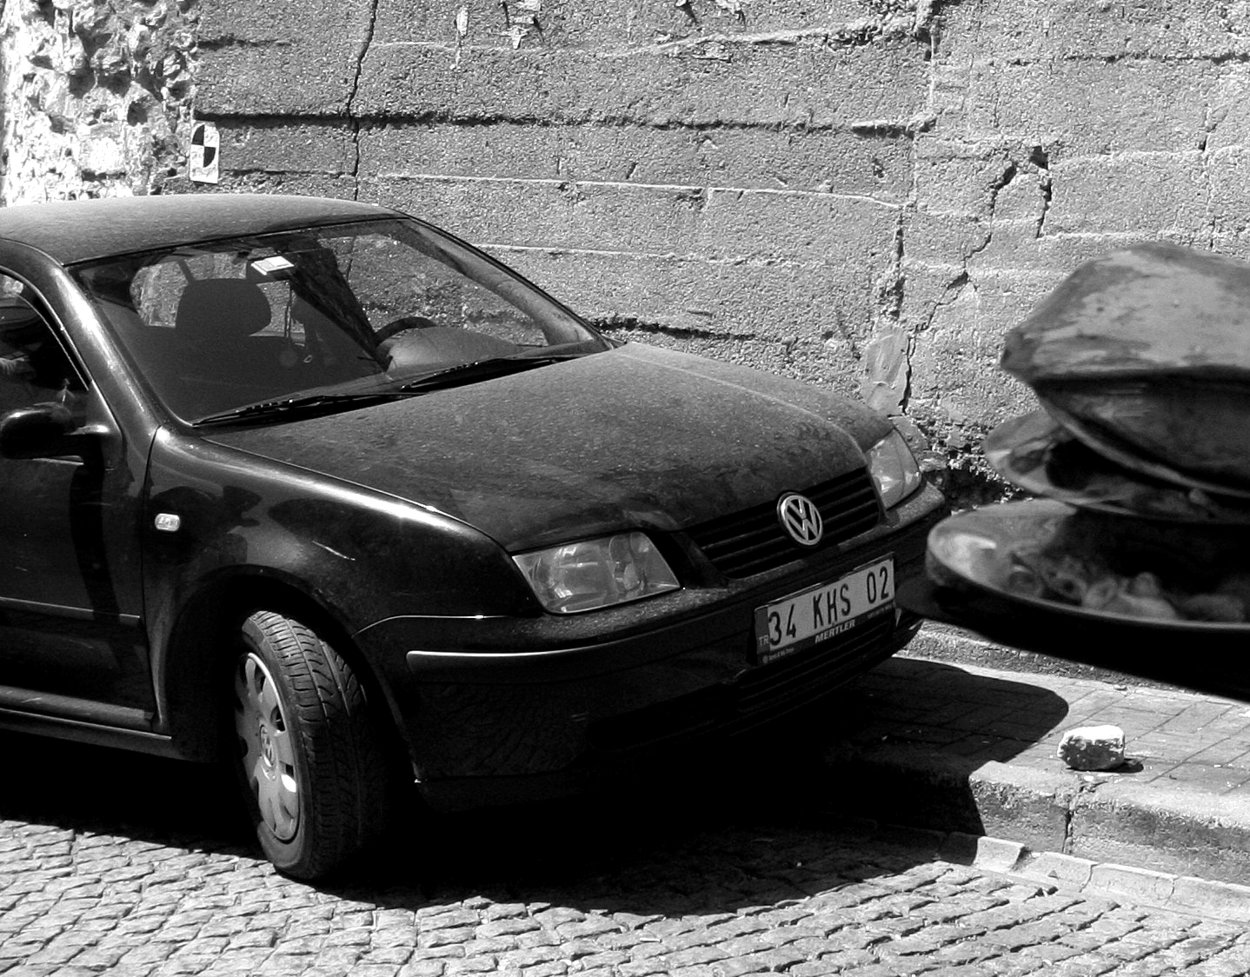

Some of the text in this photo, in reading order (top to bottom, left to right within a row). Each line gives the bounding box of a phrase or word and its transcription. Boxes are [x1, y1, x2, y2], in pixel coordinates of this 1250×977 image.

[769, 566, 889, 646] 34 KHS 02
[759, 635, 769, 646] TR
[815, 618, 855, 643] MERTLER
